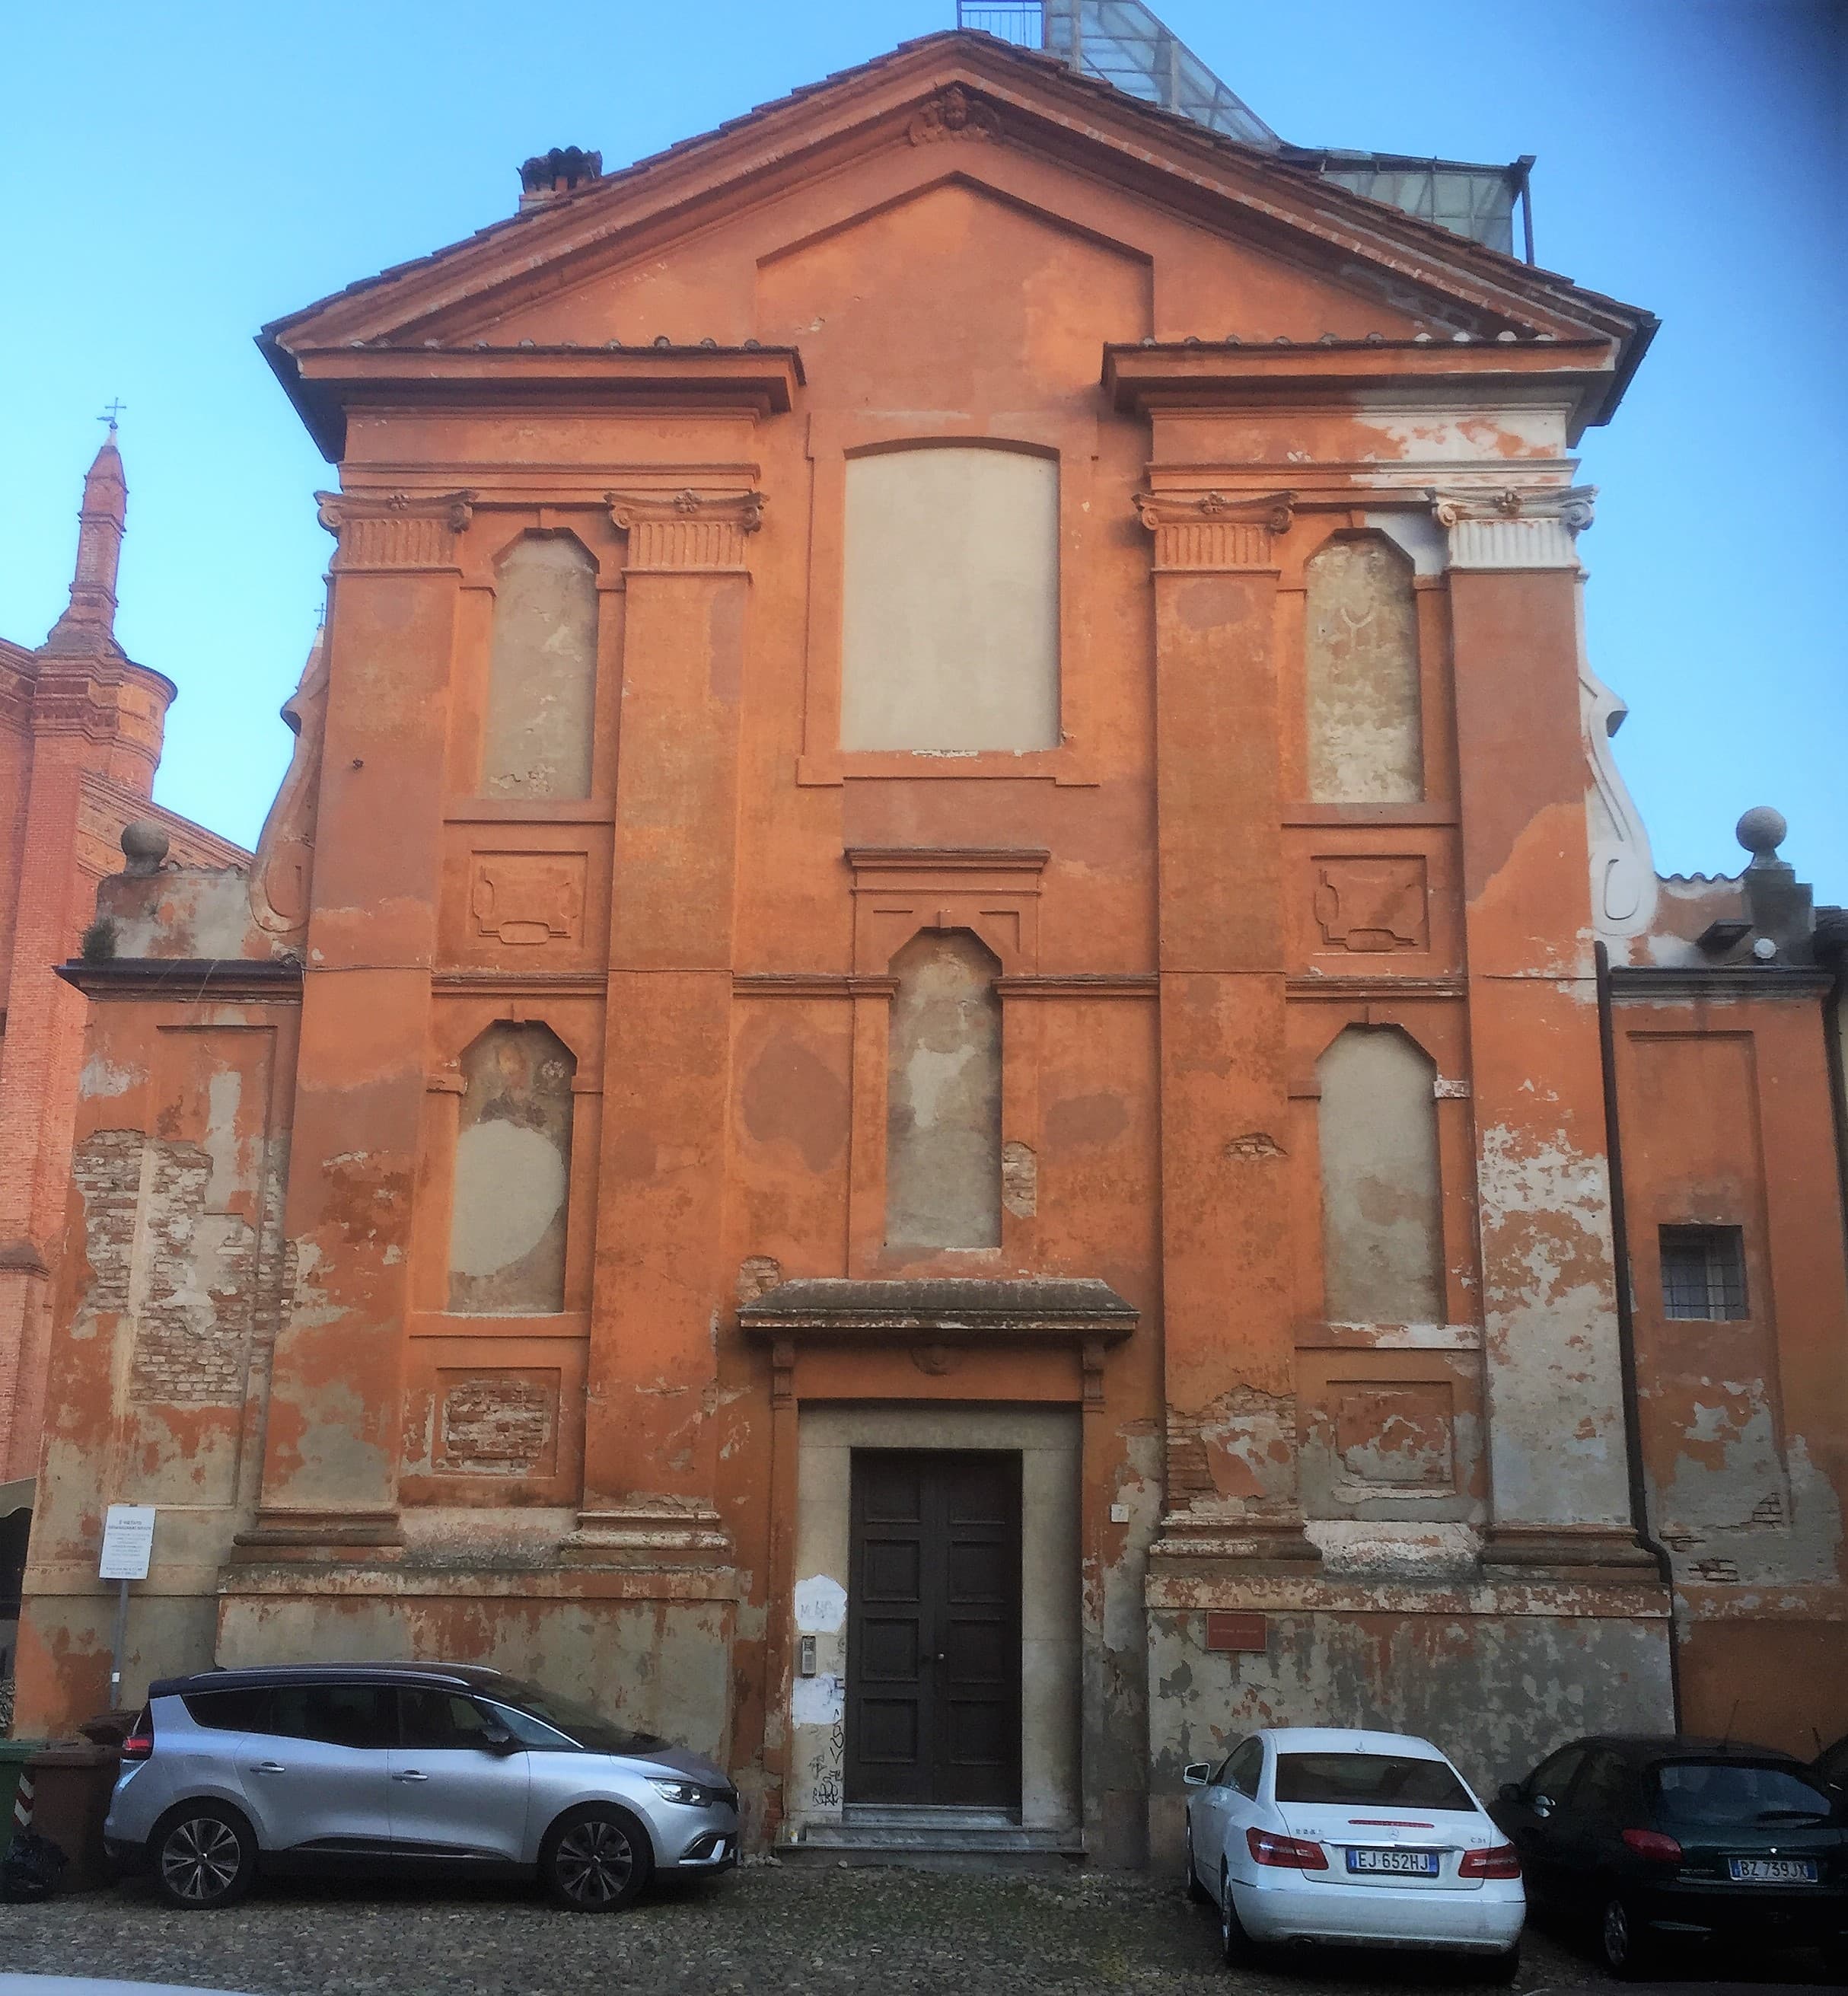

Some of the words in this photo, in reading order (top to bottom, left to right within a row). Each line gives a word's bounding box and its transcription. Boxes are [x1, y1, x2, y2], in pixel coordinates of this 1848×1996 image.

[1358, 1851, 1377, 1867] EJ
[1382, 1853, 1429, 1870] 652HJ
[1740, 1860, 1759, 1876] BZ
